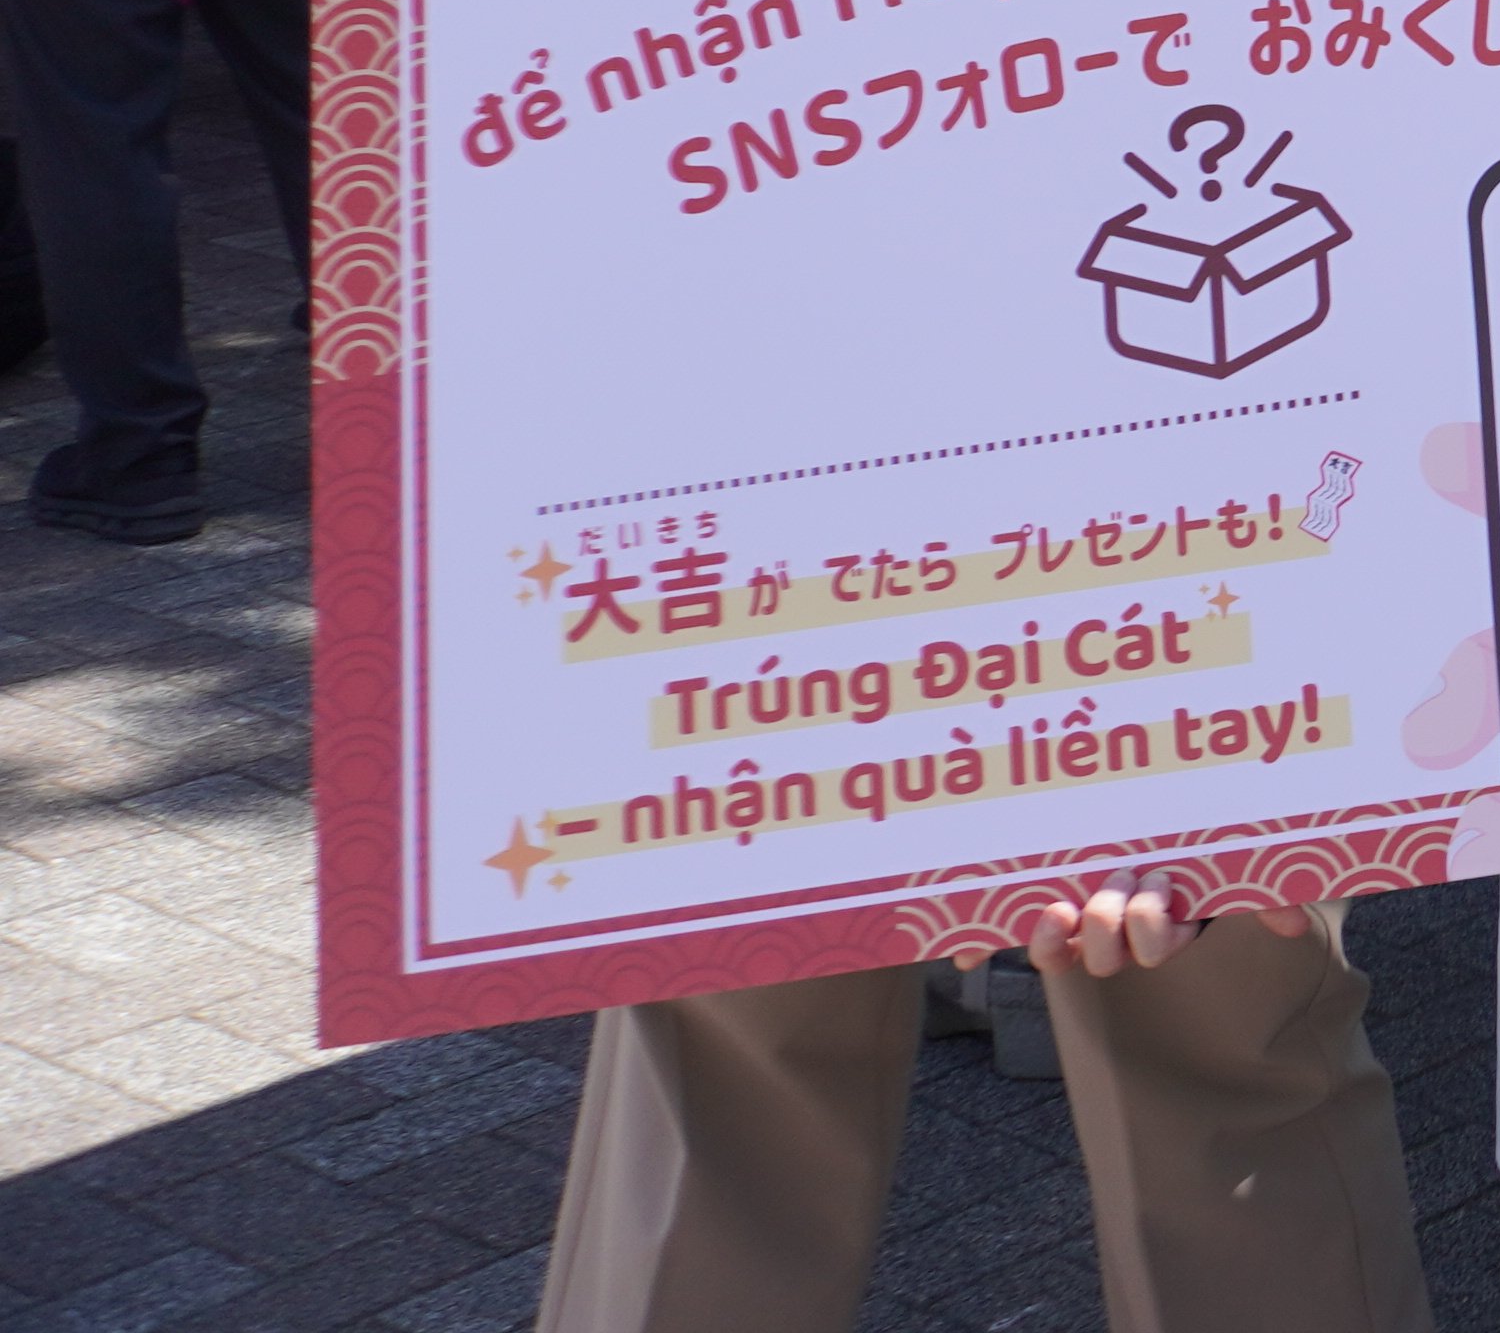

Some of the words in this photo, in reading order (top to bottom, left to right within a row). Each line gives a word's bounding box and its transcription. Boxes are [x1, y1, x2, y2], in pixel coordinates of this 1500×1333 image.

[460, 48, 568, 169] để
[667, 11, 1192, 214] SNSフォローで
[577, 511, 719, 556] だいきち
[823, 541, 957, 602] でたら
[993, 493, 1284, 581] プレゼントも!
[666, 655, 890, 737] Trúng
[914, 621, 1040, 711] Đại
[1066, 602, 1190, 678] Cát
[622, 758, 815, 847] nhận
[841, 728, 984, 821] quà
[1008, 696, 1150, 784] liền
[1173, 683, 1324, 767] tay!
